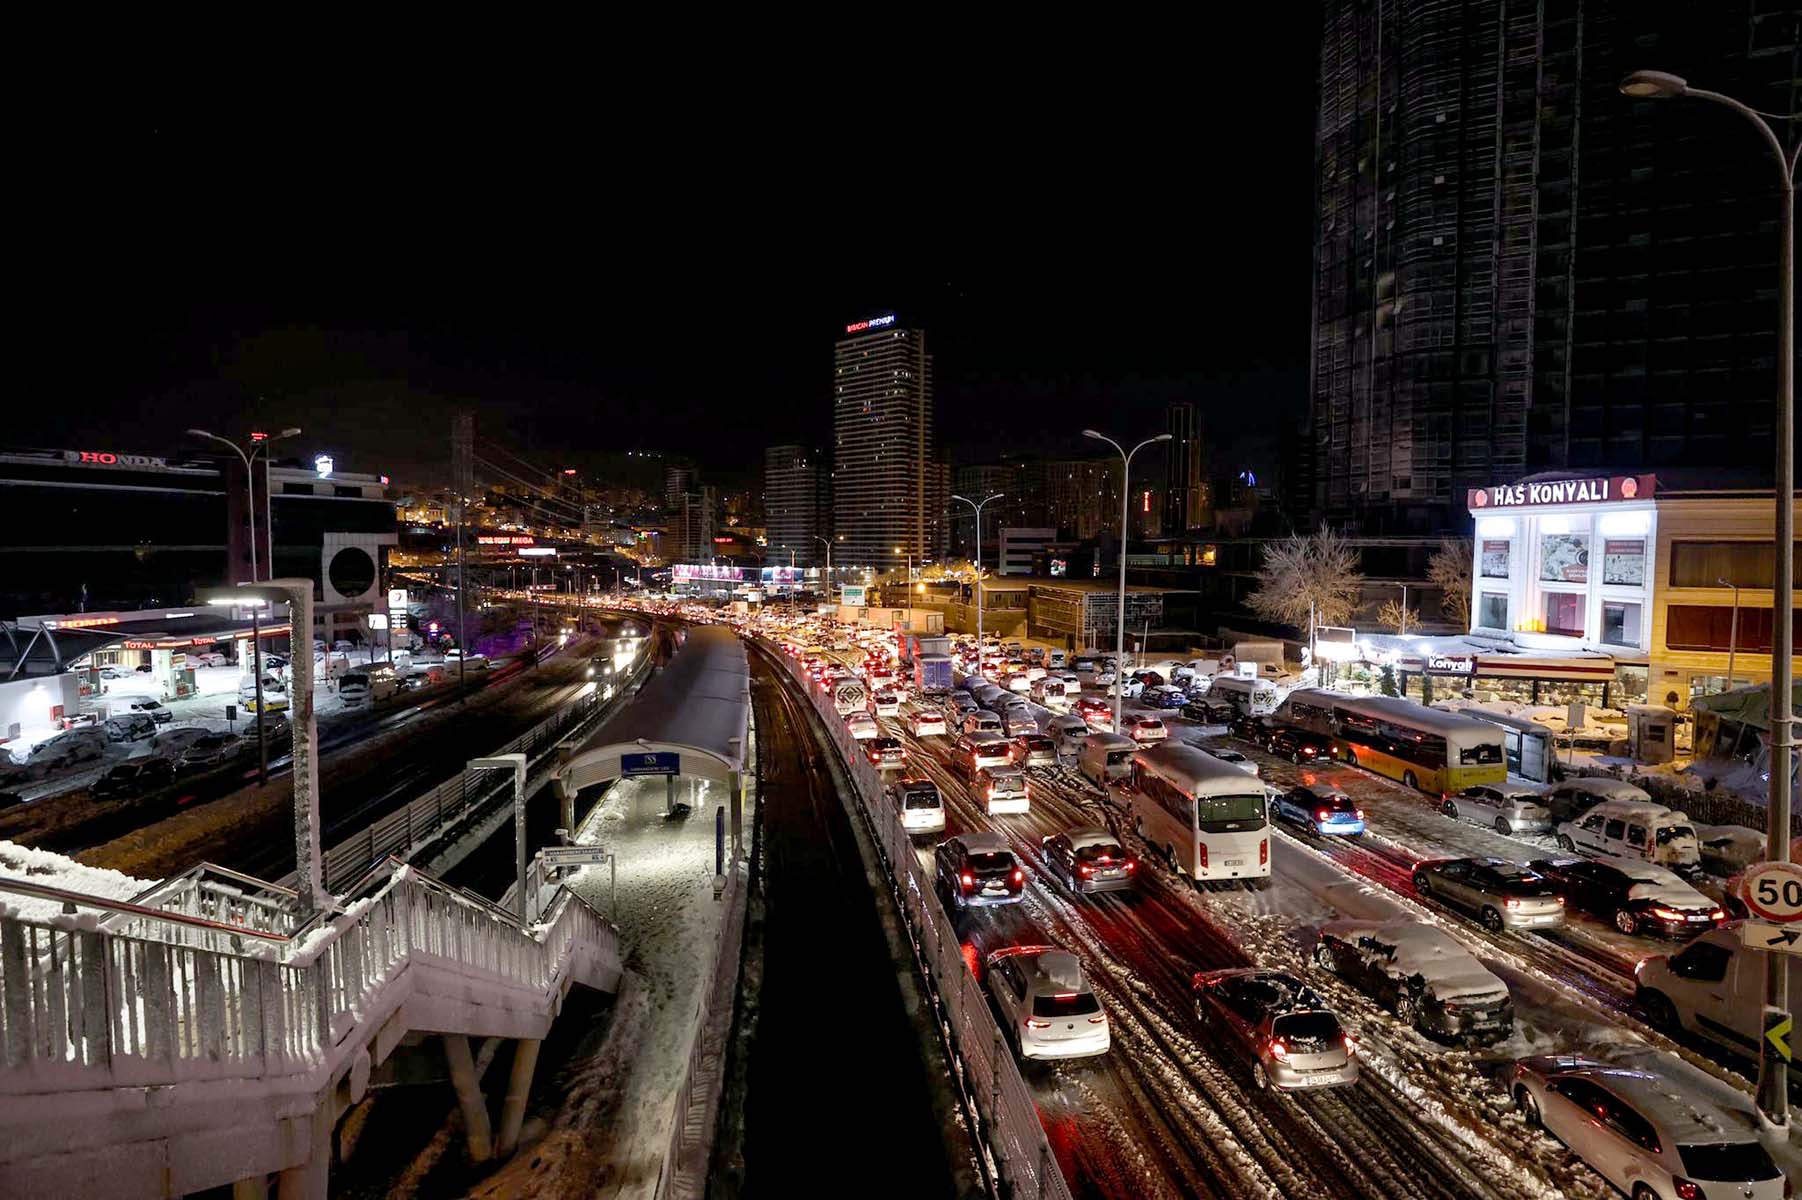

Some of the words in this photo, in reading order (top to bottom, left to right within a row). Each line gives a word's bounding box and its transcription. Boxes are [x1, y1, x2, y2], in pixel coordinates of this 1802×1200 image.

[80, 451, 166, 468] HONDA
[1494, 486, 1525, 506] HAS
[1530, 479, 1609, 504] KONYALI
[511, 536, 534, 545] MEGA
[60, 617, 119, 629] HONDA
[124, 640, 154, 649] TOTAL
[193, 637, 217, 646] TOTAL
[1758, 879, 1802, 908] 50
